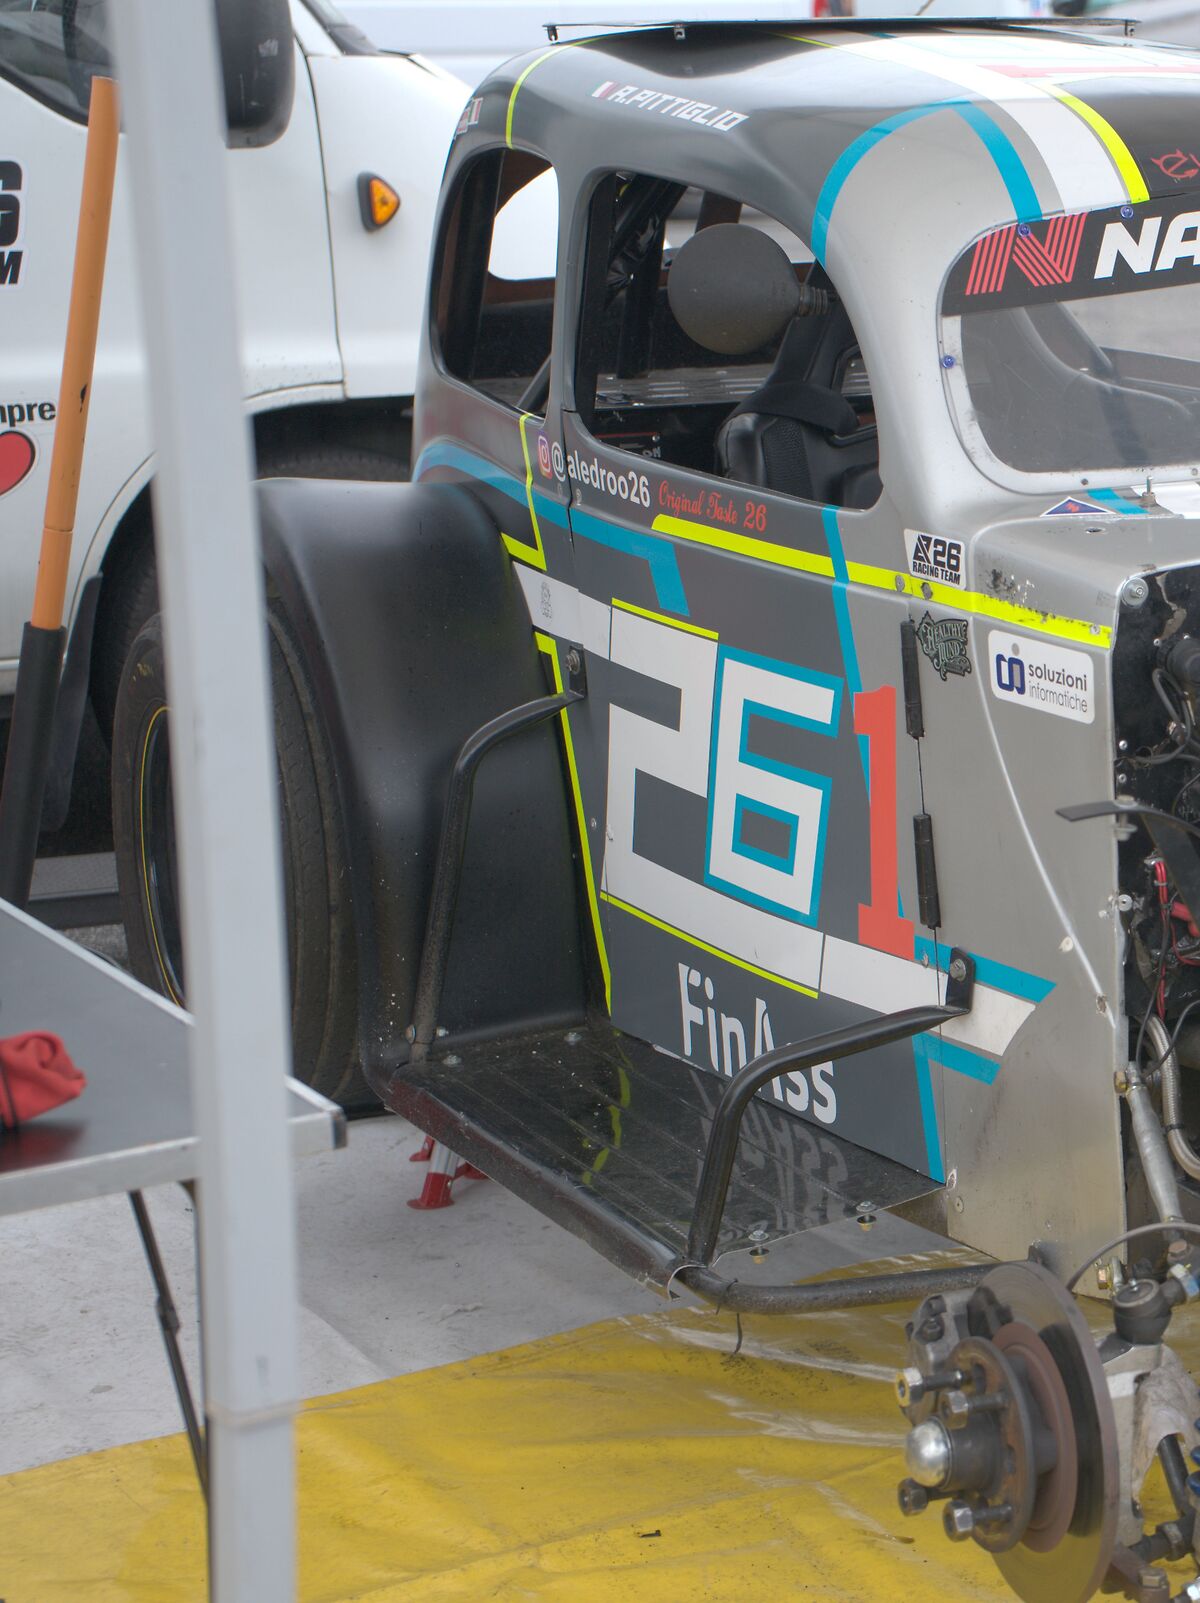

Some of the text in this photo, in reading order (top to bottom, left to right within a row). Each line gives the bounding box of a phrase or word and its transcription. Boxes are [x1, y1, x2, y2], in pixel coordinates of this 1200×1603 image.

[607, 85, 750, 132] A.PITTIGLIO
[551, 441, 650, 508] @aledroo26
[658, 479, 702, 518] Original
[743, 501, 767, 533] 26
[912, 561, 961, 586] RACING TEAM
[1028, 663, 1087, 692] soluzioni
[1028, 681, 1088, 713] informatiche
